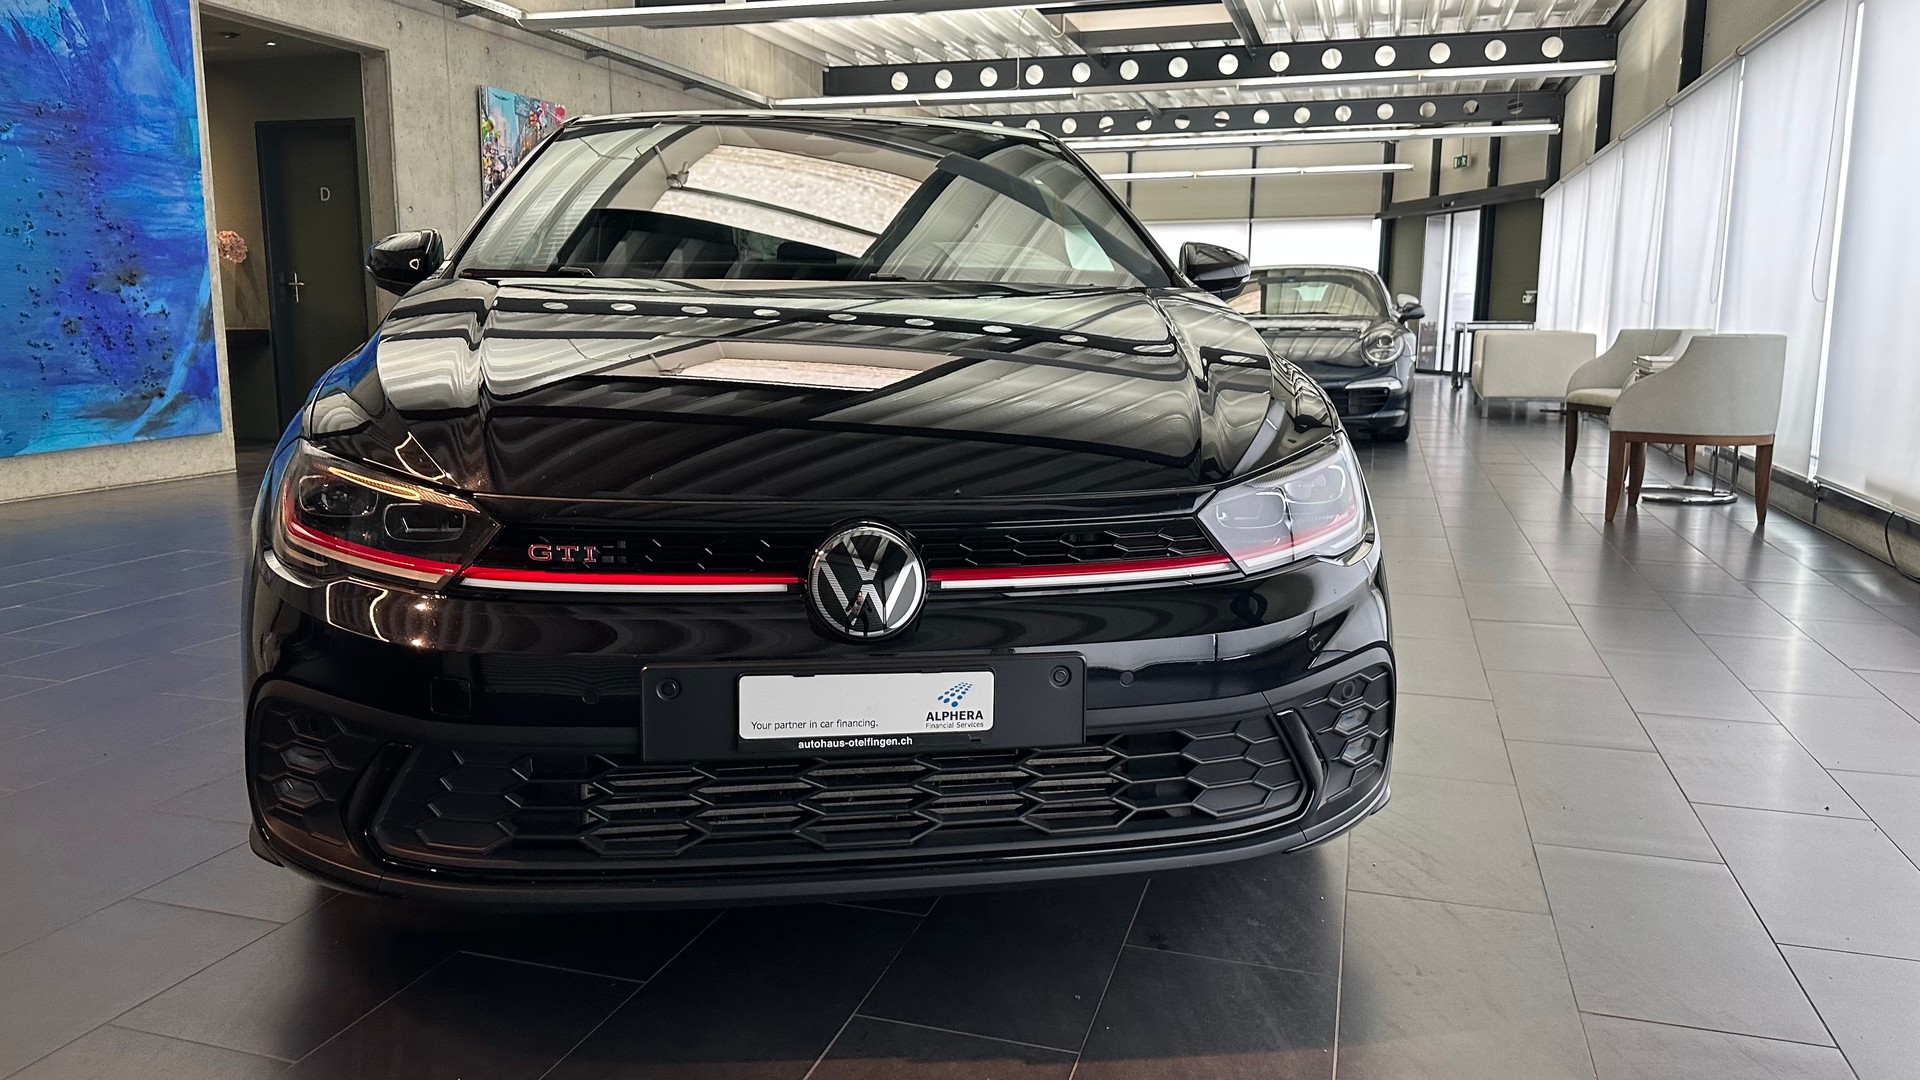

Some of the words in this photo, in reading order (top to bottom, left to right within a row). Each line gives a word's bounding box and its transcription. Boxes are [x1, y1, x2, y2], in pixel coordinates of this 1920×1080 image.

[320, 186, 331, 201] D
[527, 543, 598, 563] GTI
[812, 526, 923, 637] VW
[925, 710, 984, 722] ALPHERA
[751, 720, 772, 730] Your
[774, 719, 807, 731] partner
[809, 719, 818, 729] in
[819, 720, 834, 729] car
[836, 718, 879, 729] financing.
[925, 721, 955, 730] Financial
[956, 720, 984, 729] Services
[798, 735, 913, 750] autohaus-otelfingen.ch
